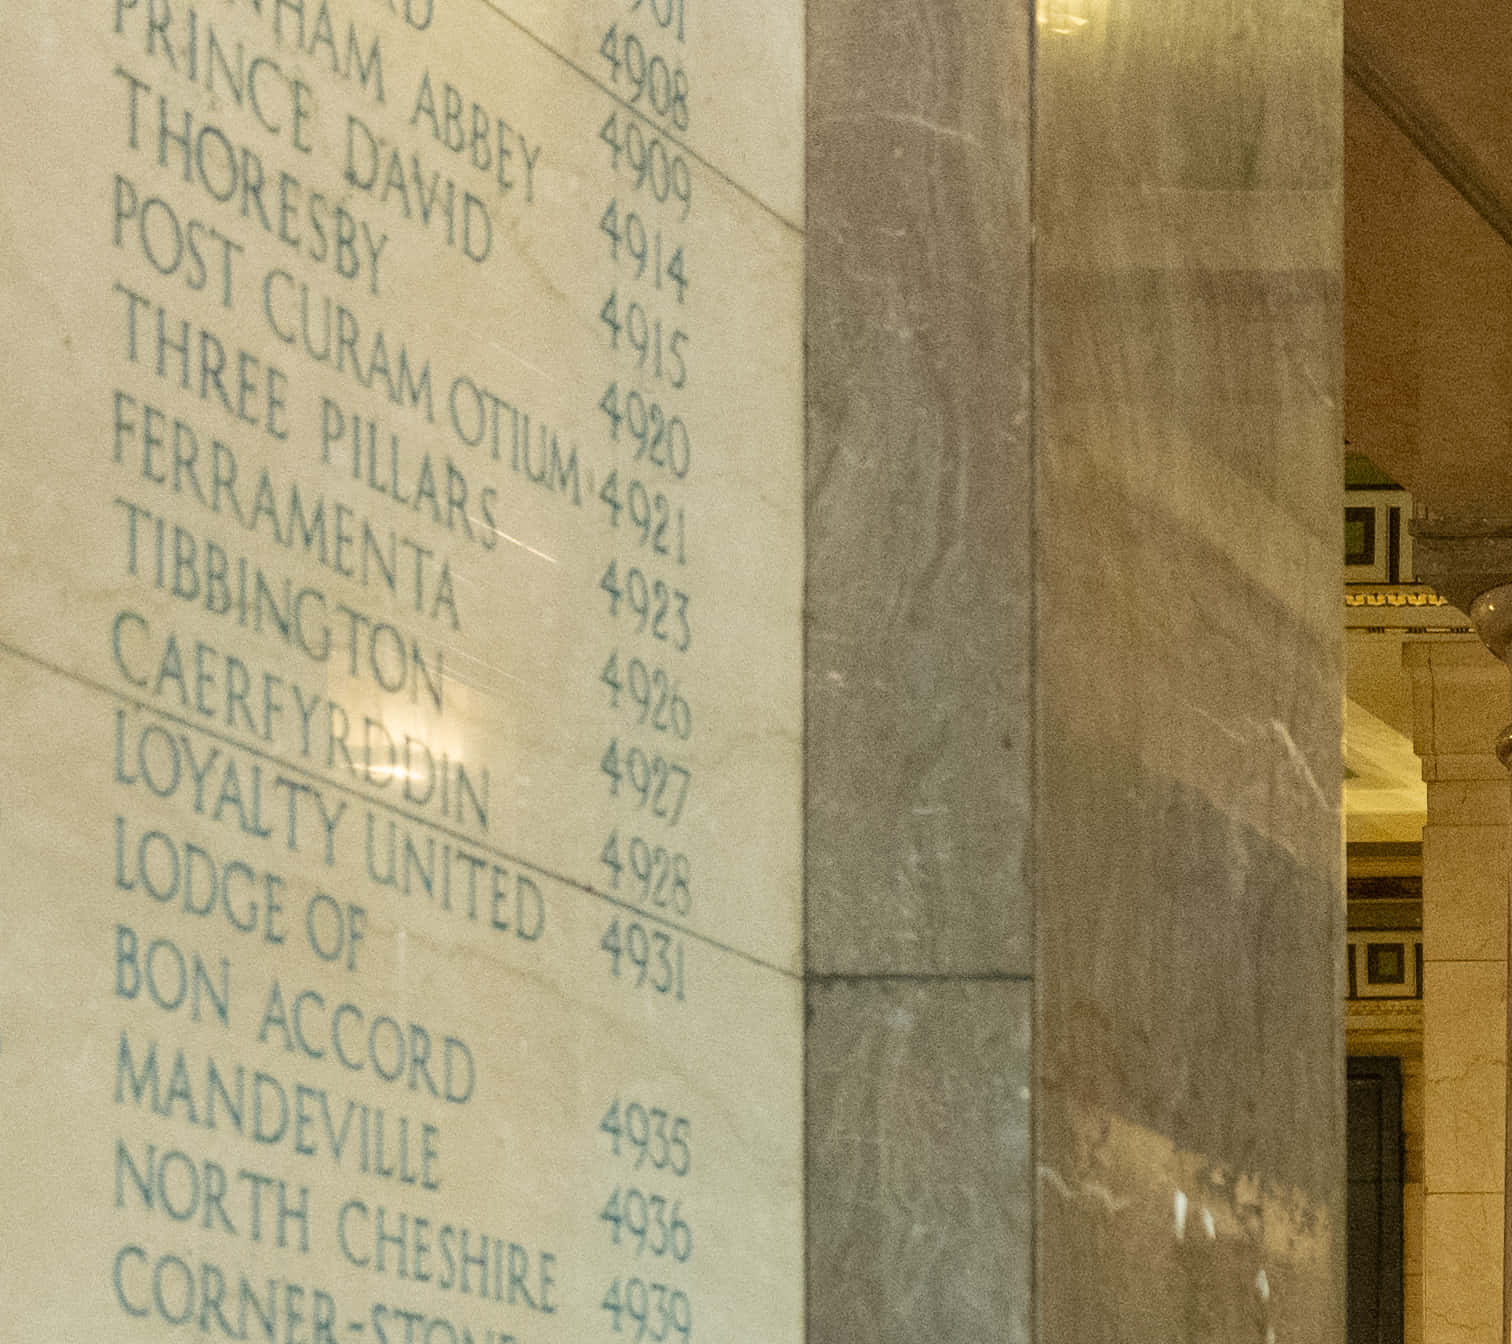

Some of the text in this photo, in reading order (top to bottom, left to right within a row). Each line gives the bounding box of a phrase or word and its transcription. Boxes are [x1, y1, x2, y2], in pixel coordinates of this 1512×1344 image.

[411, 70, 690, 305] ABBEY 4914
[599, 111, 692, 224] 4909
[600, 23, 690, 132] 4908
[112, 172, 687, 566] POST CURAM OTIUM 4921
[113, 63, 690, 480] THORESBY 4920
[343, 114, 494, 265] DAVID
[599, 291, 689, 391] 4915
[113, 391, 693, 743] FERRAMENTA 4926
[114, 282, 693, 653] THREE PILLARS 4923
[111, 609, 693, 919] CAERFYRDDIN 4928
[114, 496, 693, 829] TIBBINGTON 4927
[114, 815, 368, 971] LODGE OF
[115, 708, 687, 1002] LOYALTY UNITED 4931
[114, 925, 693, 1178] BON ACCORD 4935
[114, 1033, 693, 1265] MANDEVILLE 4936
[114, 1139, 311, 1256] NORTH
[338, 1198, 560, 1316] CHESHIRE
